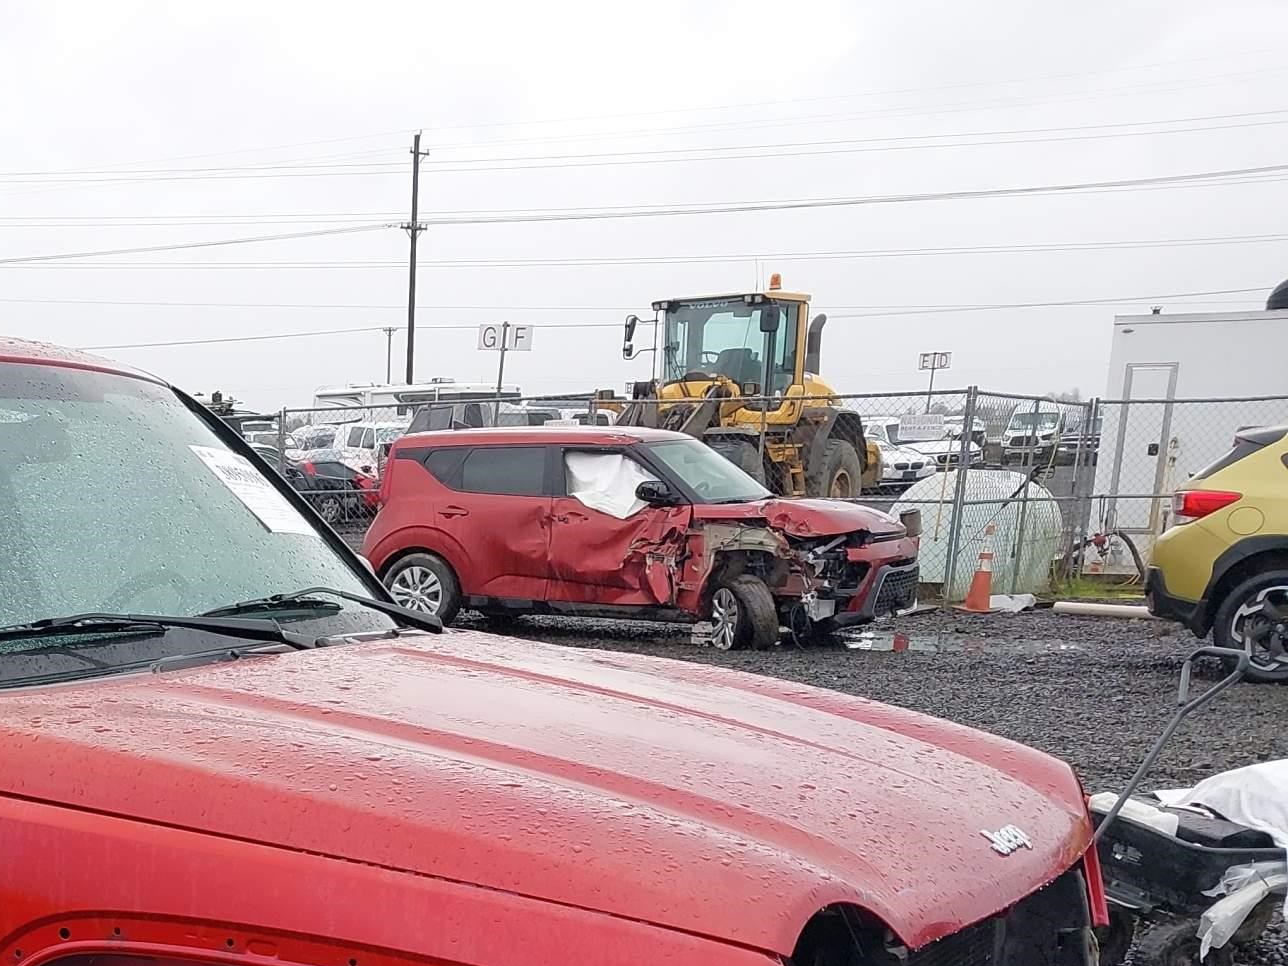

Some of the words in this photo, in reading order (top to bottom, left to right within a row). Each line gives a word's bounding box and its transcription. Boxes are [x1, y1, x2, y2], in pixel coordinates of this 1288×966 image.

[483, 326, 497, 348] G
[514, 327, 527, 348] F
[921, 354, 930, 369] E
[939, 353, 948, 368] D
